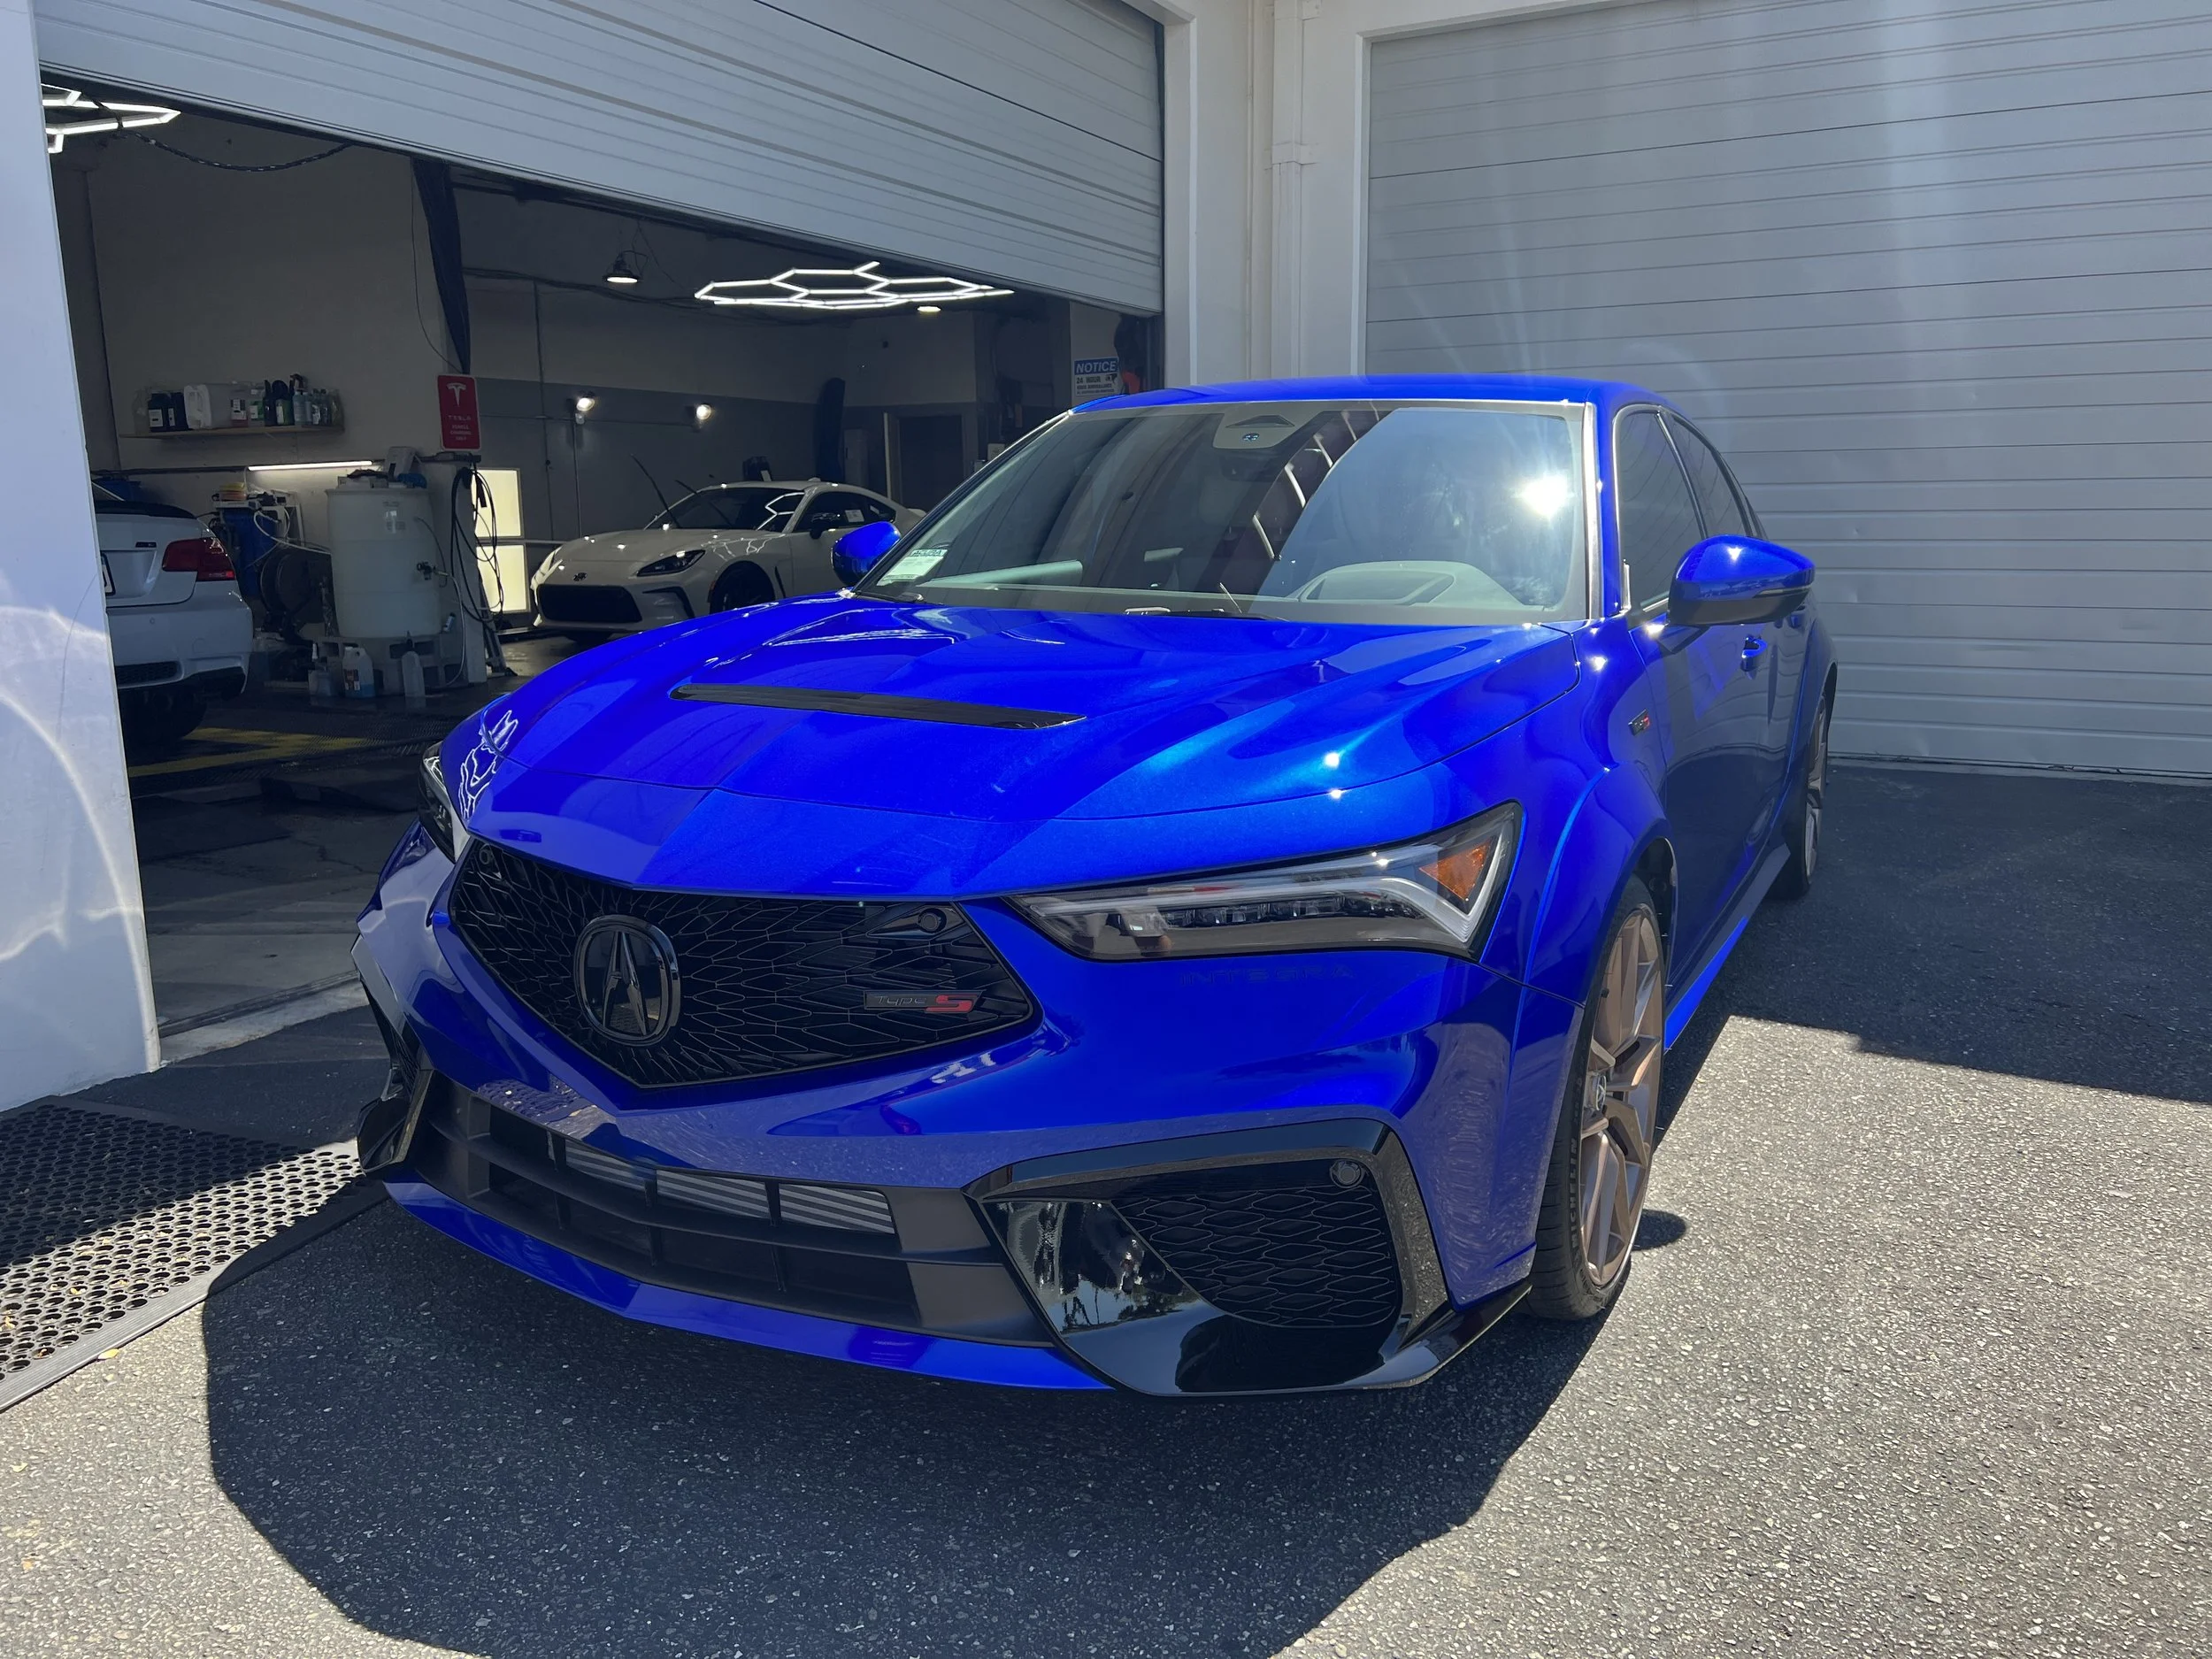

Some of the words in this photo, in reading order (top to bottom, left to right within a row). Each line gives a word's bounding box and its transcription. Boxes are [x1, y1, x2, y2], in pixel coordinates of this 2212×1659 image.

[1076, 361, 1117, 373] NOTICE
[1180, 964, 1356, 986] INTEGRA
[874, 995, 927, 1006] Type
[925, 994, 979, 1013] S
[1569, 1138, 1578, 1248] MICHELIN
